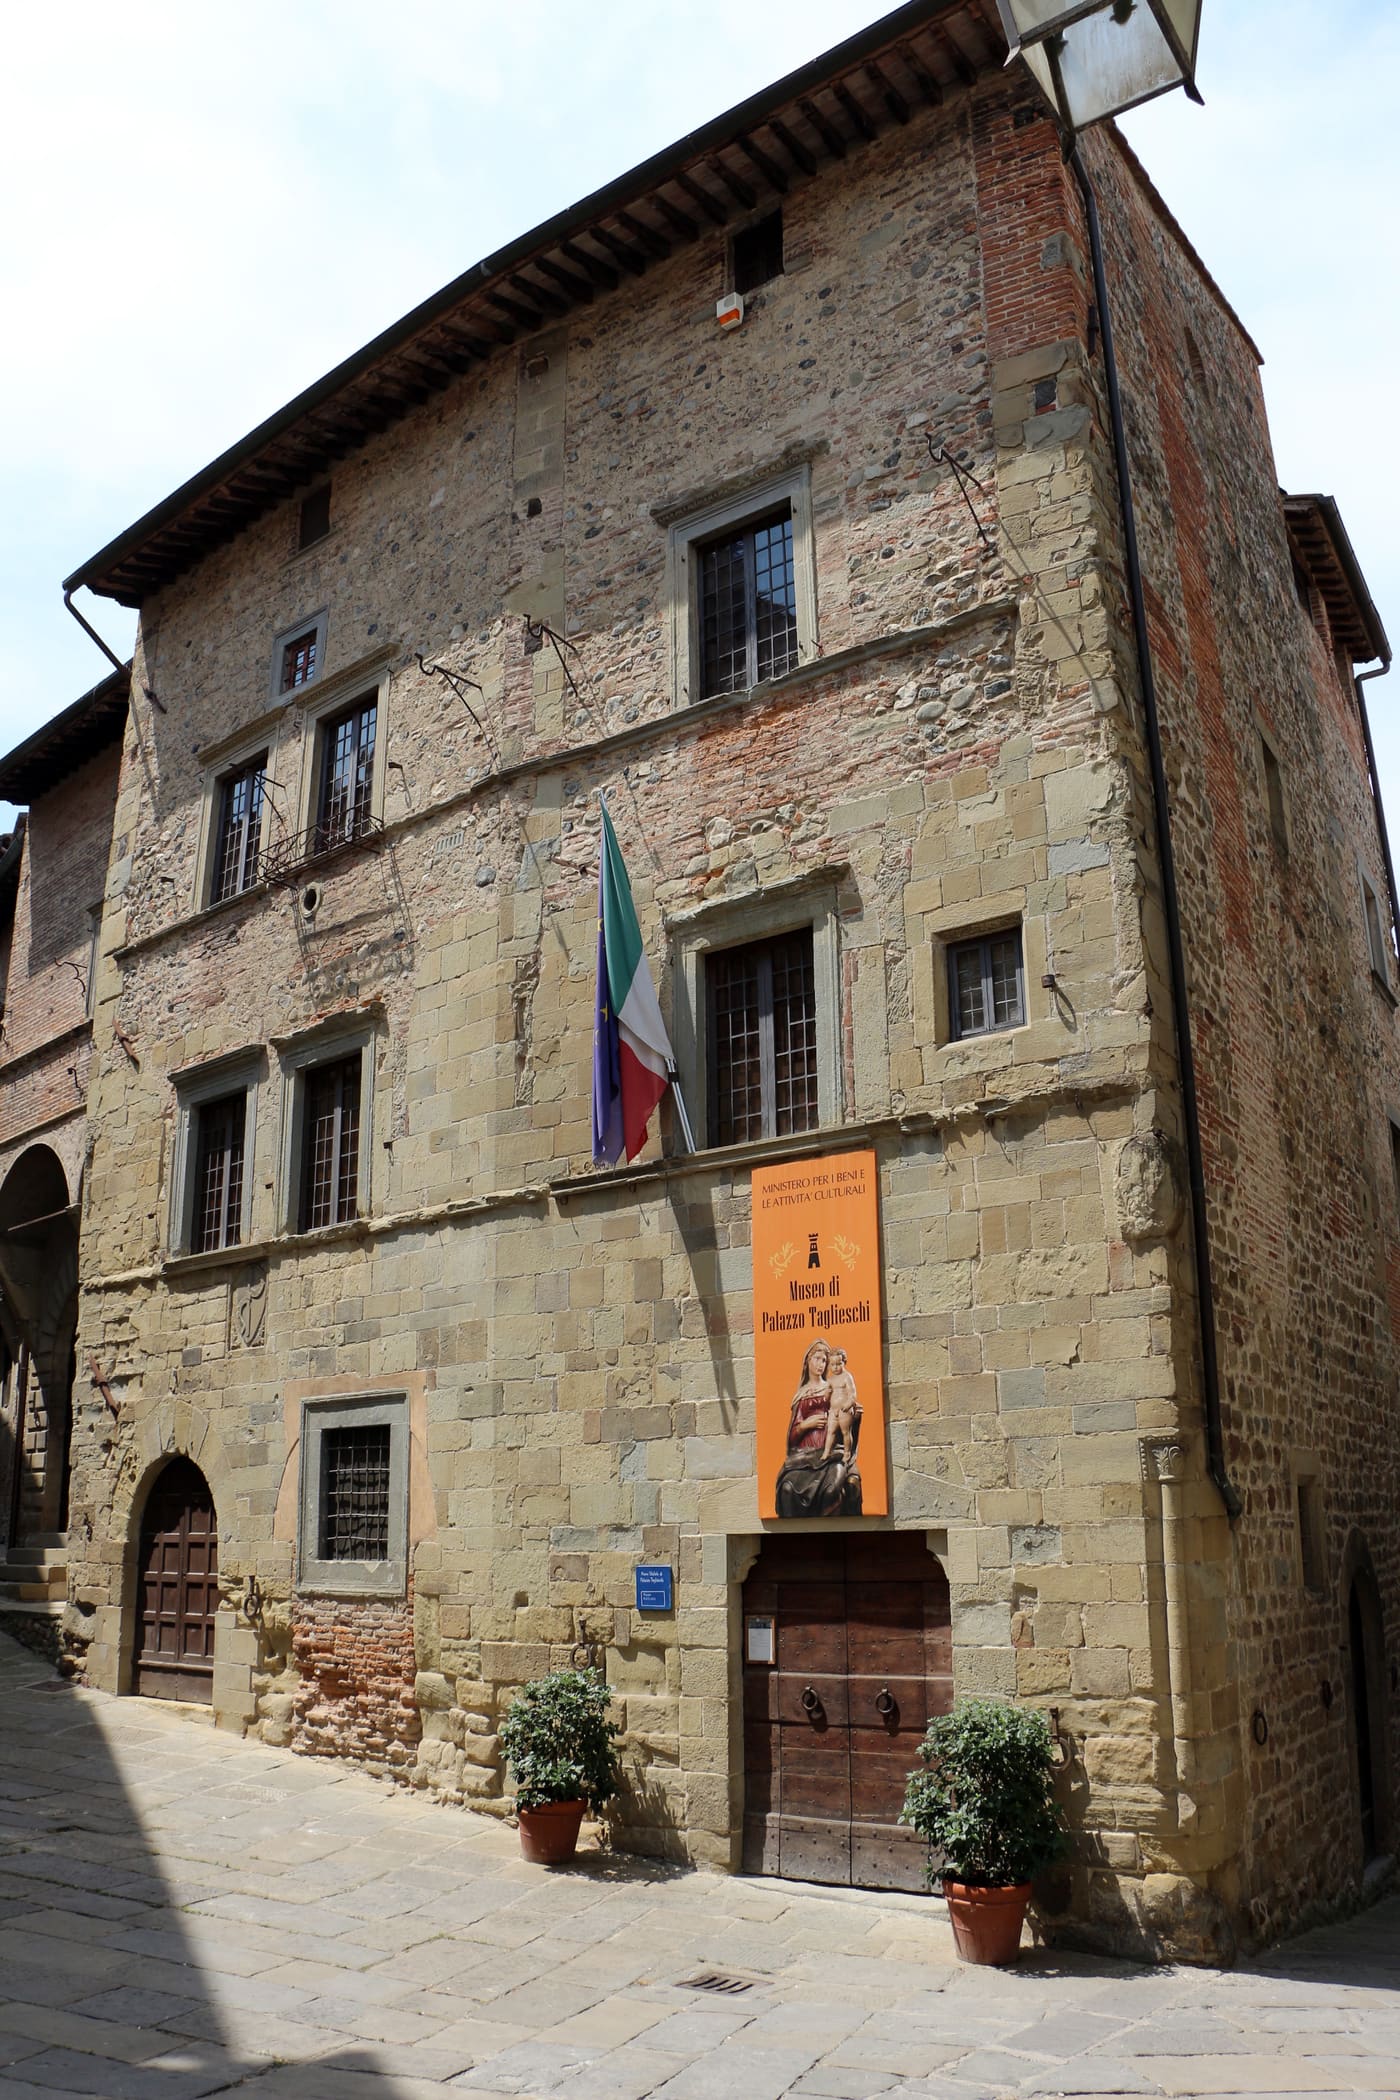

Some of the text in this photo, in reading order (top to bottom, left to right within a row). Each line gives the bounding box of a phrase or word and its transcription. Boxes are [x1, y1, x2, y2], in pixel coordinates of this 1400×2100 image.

[762, 1177, 810, 1194] MINISTERO
[812, 1175, 829, 1187] PER
[836, 1170, 858, 1182] BENI
[860, 1168, 865, 1179] E
[762, 1197, 771, 1209] LE
[815, 1183, 866, 1201] CULTURALI
[789, 1275, 840, 1301] Museo di
[762, 1300, 871, 1333] Palazzo Taglieschi
